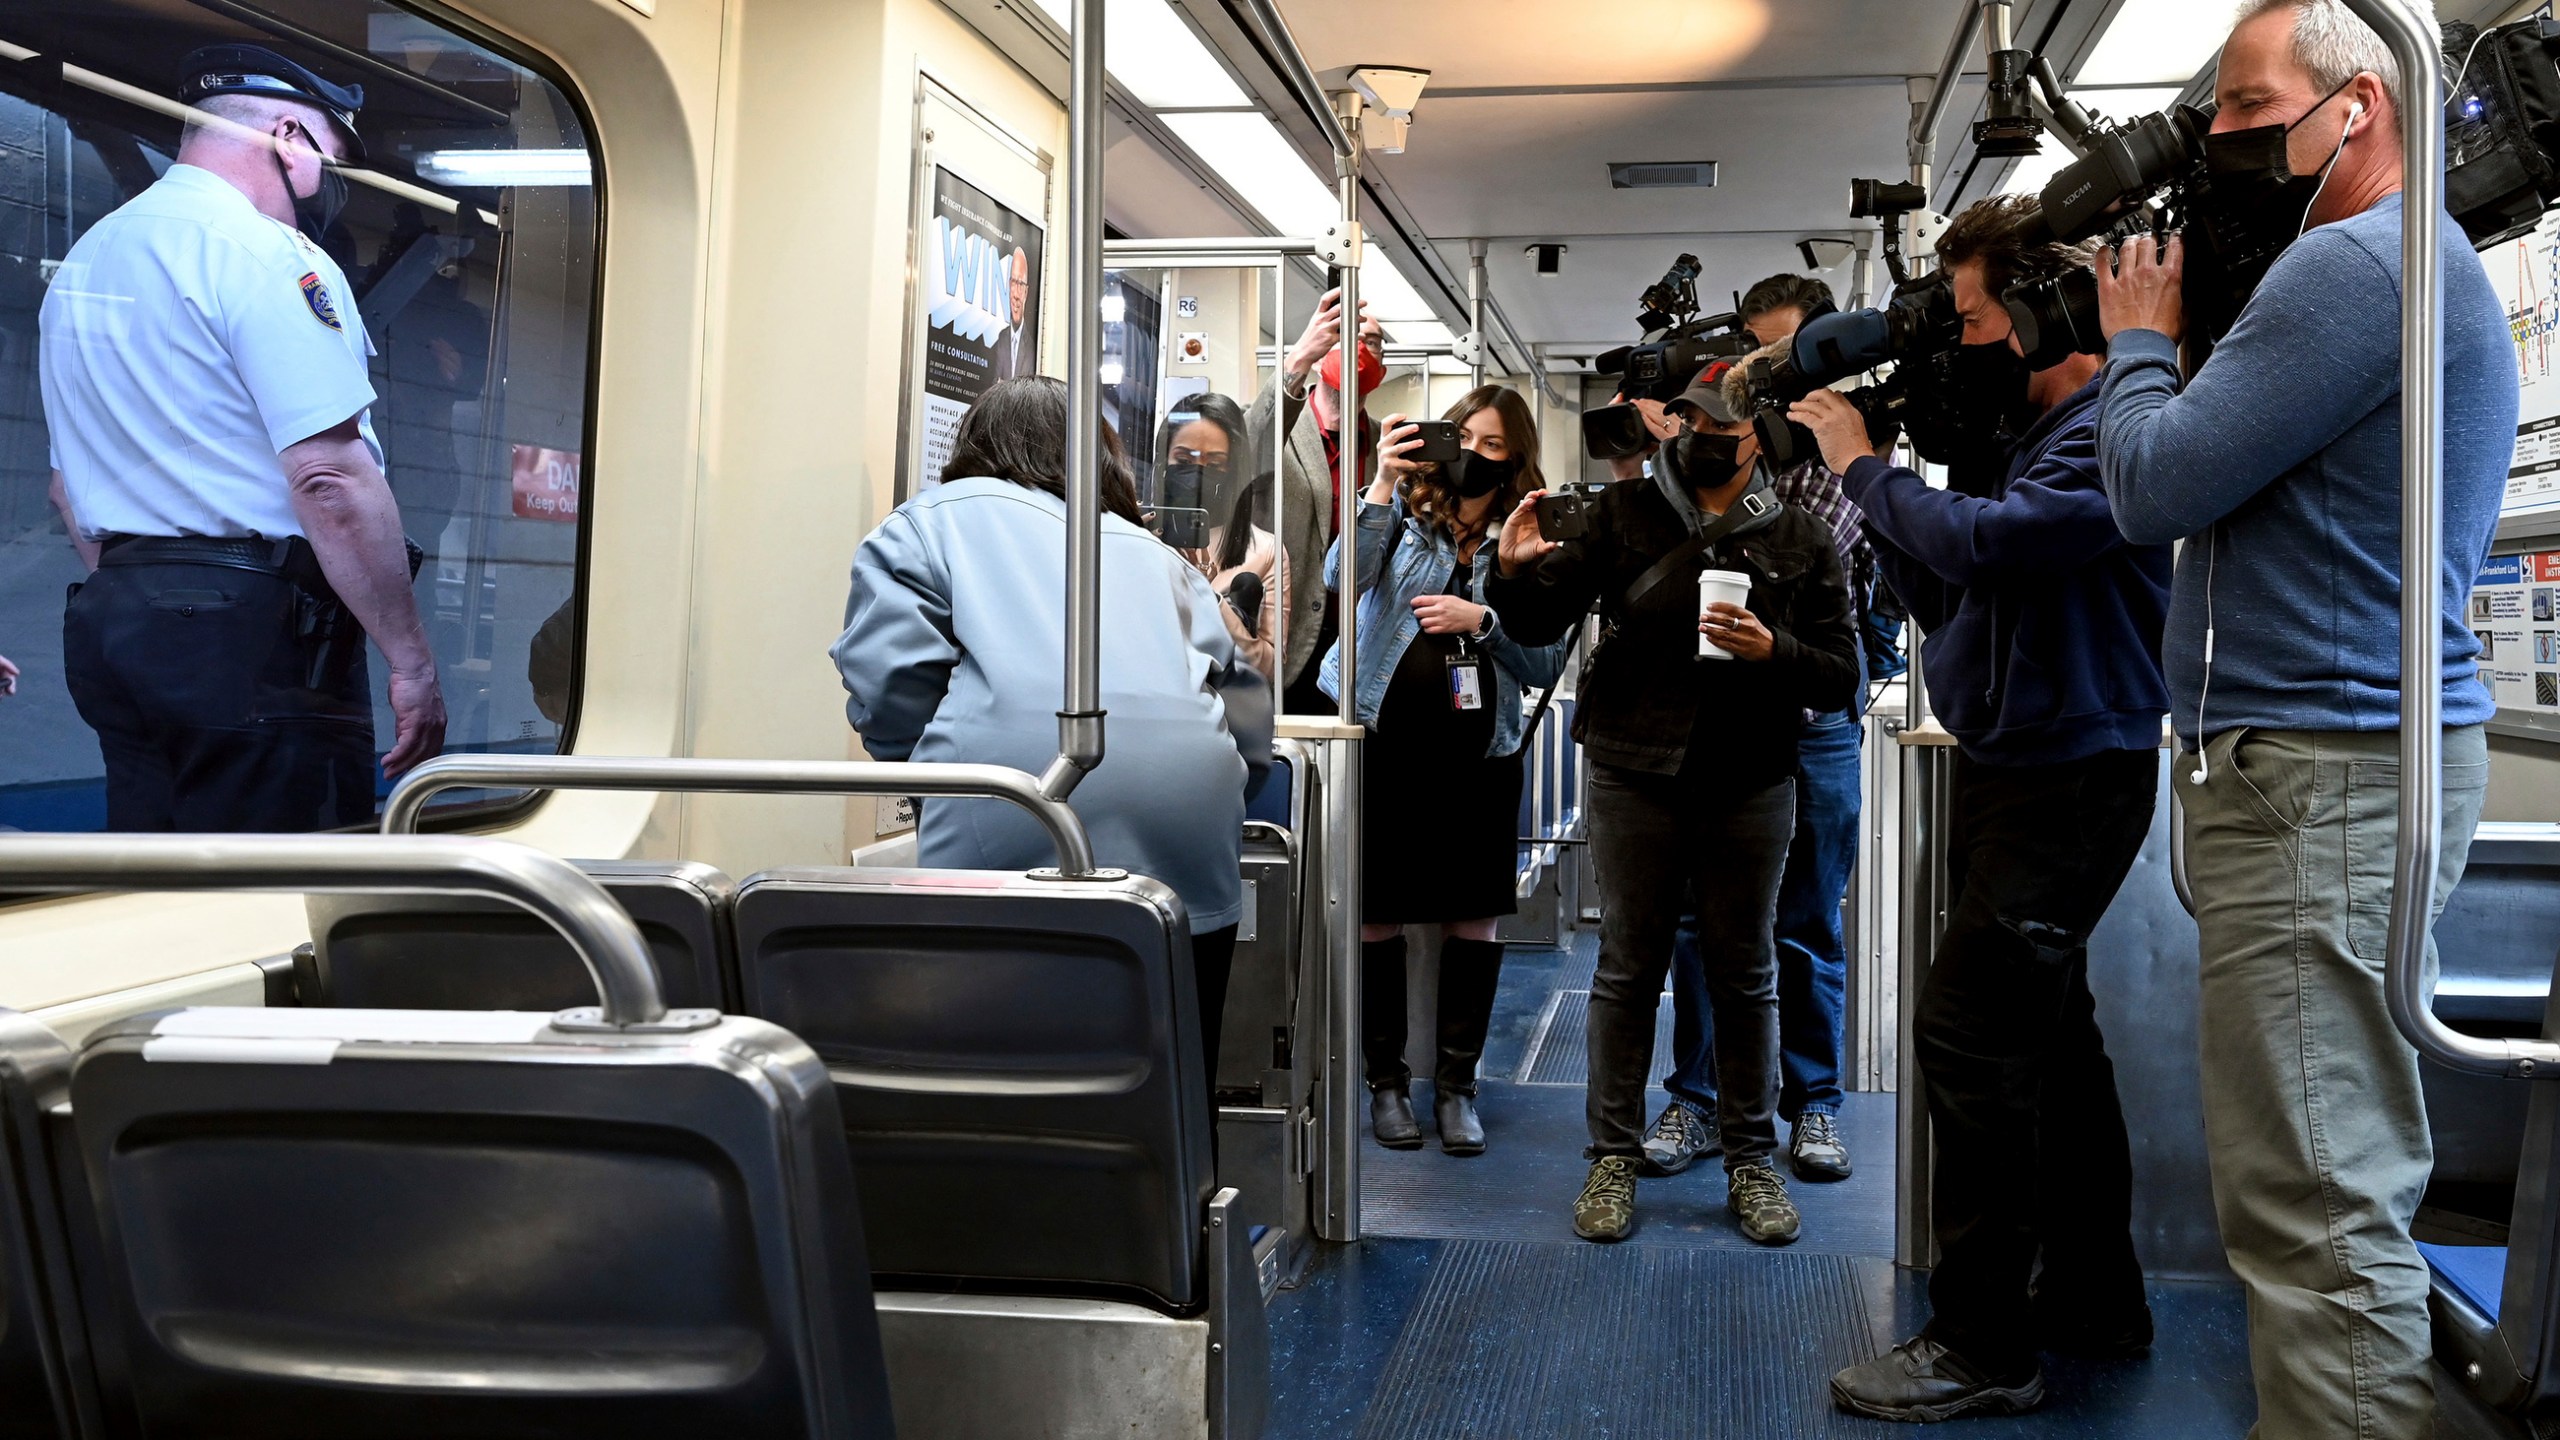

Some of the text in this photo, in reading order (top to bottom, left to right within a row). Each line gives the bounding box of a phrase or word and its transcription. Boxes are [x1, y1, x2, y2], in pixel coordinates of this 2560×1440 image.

[940, 215, 1012, 325] WIN
[1179, 300, 1197, 312] R6
[930, 340, 989, 368] FREE CONSULTATION
[931, 404, 959, 418] WORKPLACE
[930, 416, 949, 427] MEDICAL
[547, 460, 579, 493] DA
[526, 492, 555, 515] Keep
[2507, 564, 2519, 574] Line
